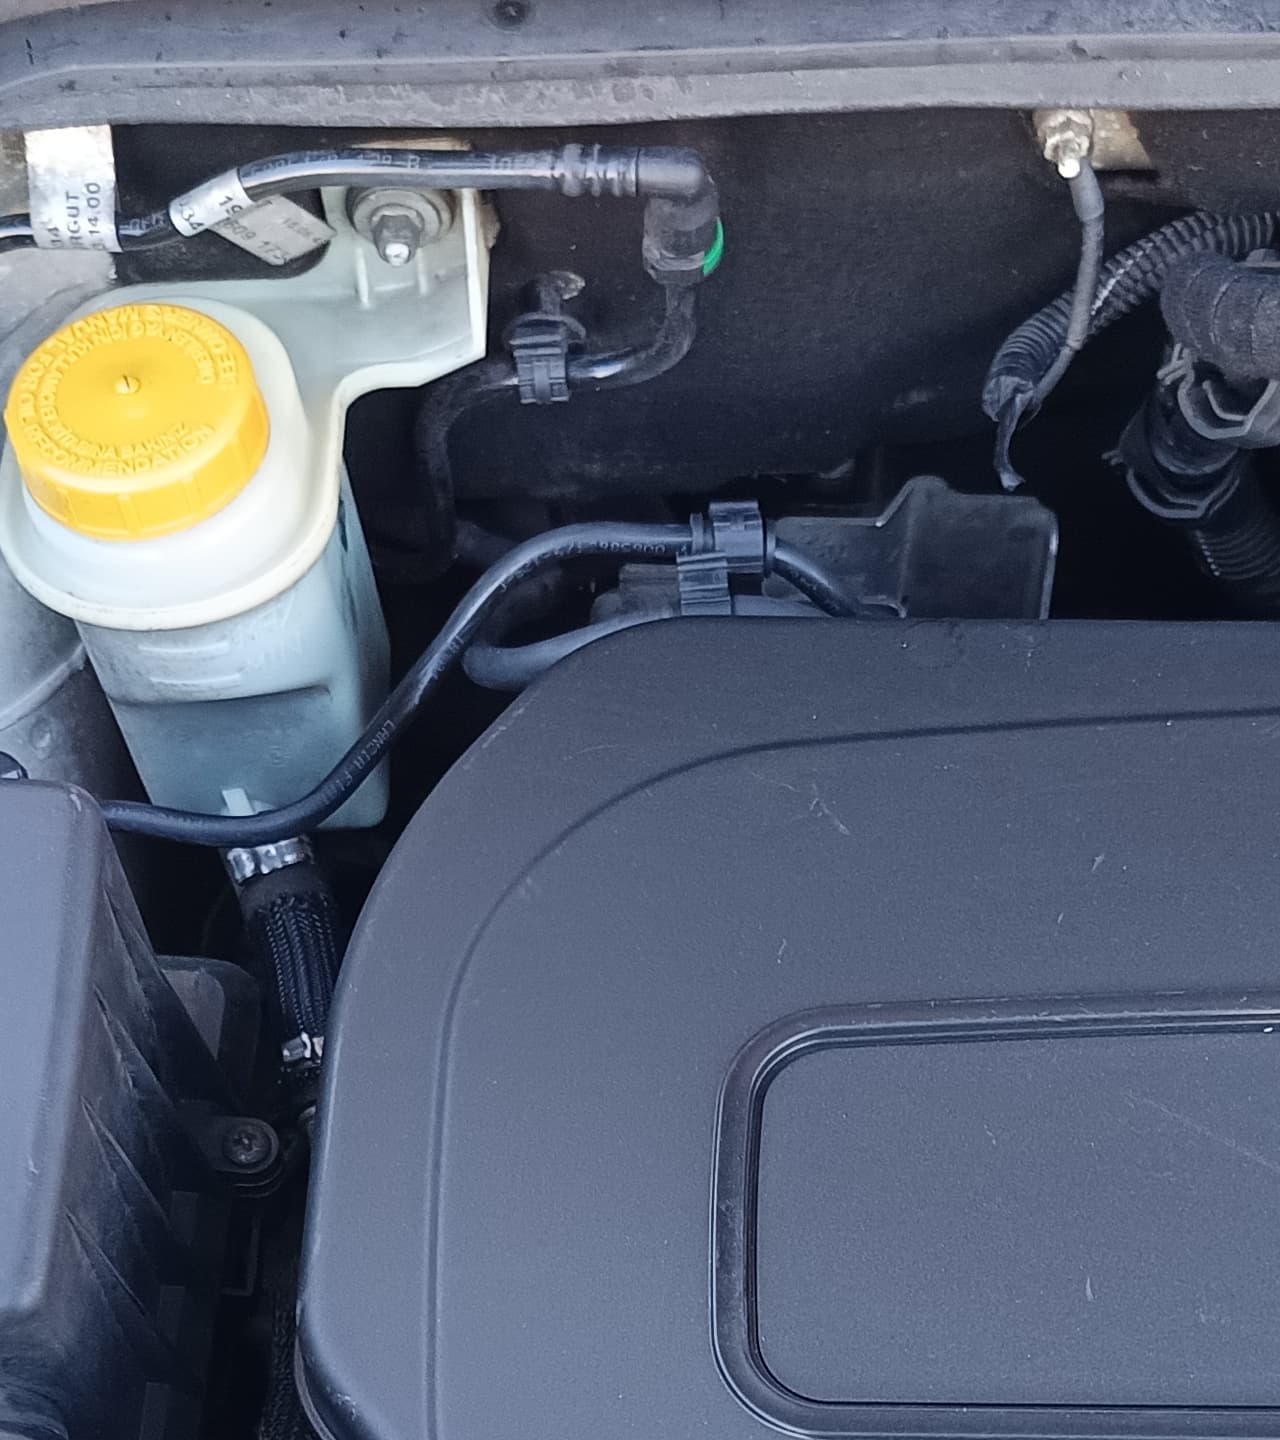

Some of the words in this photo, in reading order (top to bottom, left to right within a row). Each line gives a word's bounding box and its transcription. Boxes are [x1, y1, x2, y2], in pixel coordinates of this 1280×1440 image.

[45, 306, 140, 351] MANUAL
[19, 350, 56, 391] FOR
[17, 391, 37, 425] OIL
[23, 421, 217, 475] RECOMMENDATION
